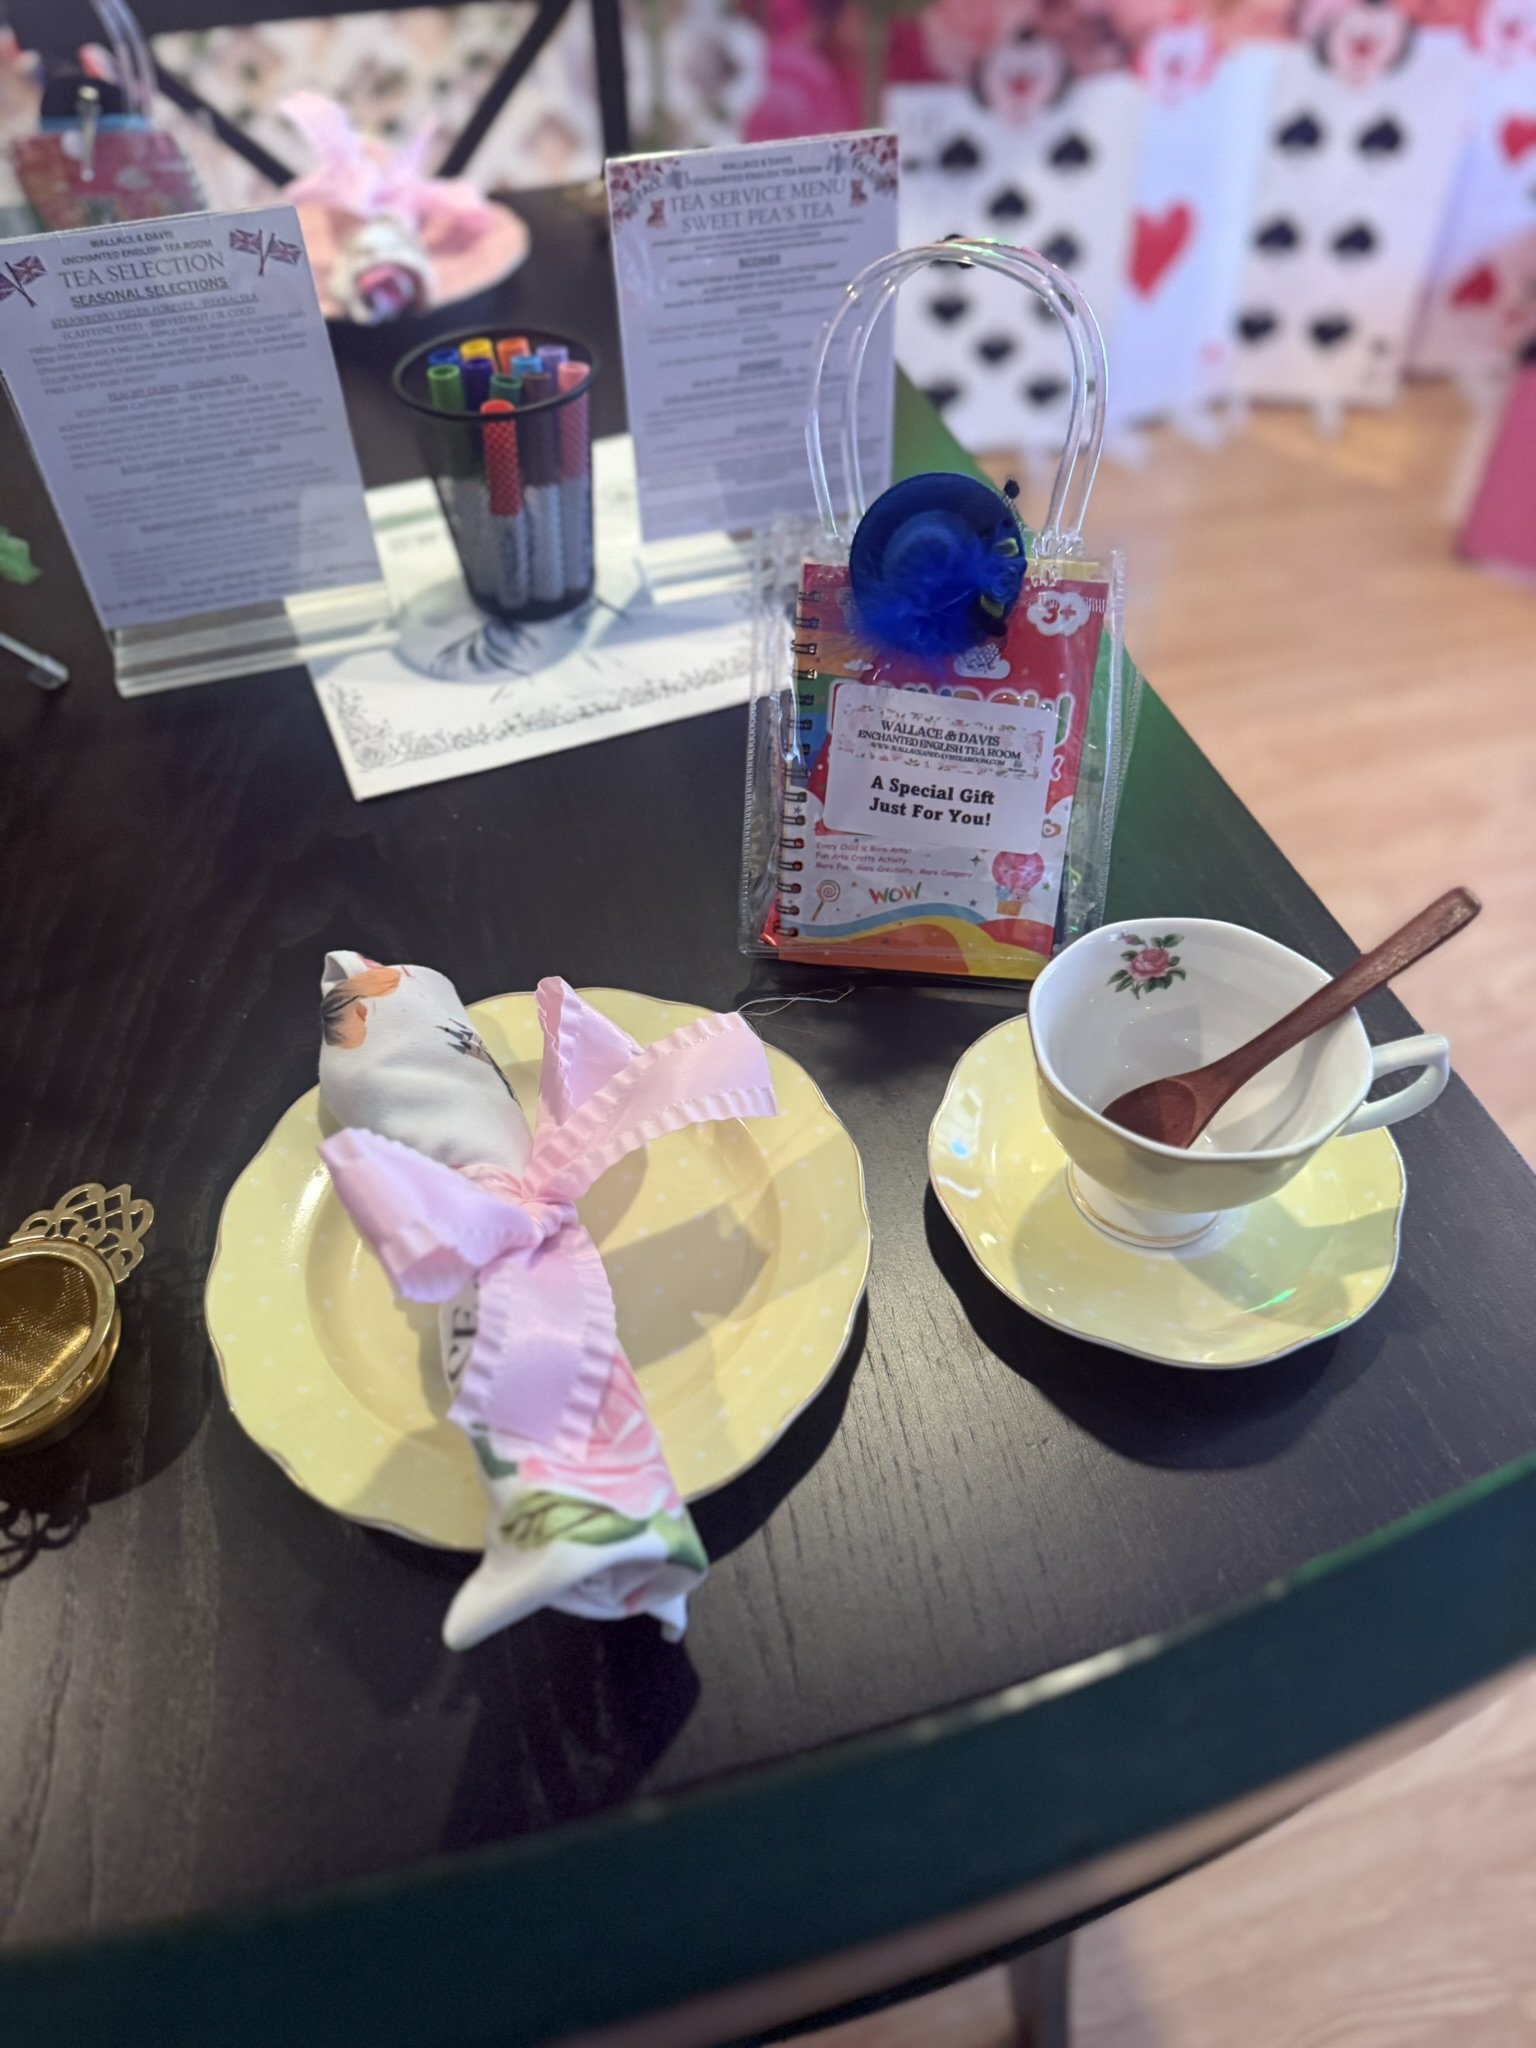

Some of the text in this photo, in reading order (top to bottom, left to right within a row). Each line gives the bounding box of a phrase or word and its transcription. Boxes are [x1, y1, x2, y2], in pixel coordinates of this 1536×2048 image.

[669, 179, 847, 214] TEA SERVICE MENU
[682, 201, 834, 234] SWEET PEA'S TEA
[89, 235, 135, 248] WALLACE
[58, 251, 226, 289] TEA SELECTION
[61, 250, 121, 266] ENCHANTED
[70, 277, 229, 308] SEASONAL SELECTIONS
[1042, 599, 1077, 625] 3+
[858, 729, 1021, 761] ENCHANTED ENGLISH TEA ROOM
[881, 719, 1000, 747] WALLACE & DAVIS
[870, 775, 995, 805] A Special Gift
[869, 797, 991, 827] Just For You!
[868, 881, 922, 904] WOW
